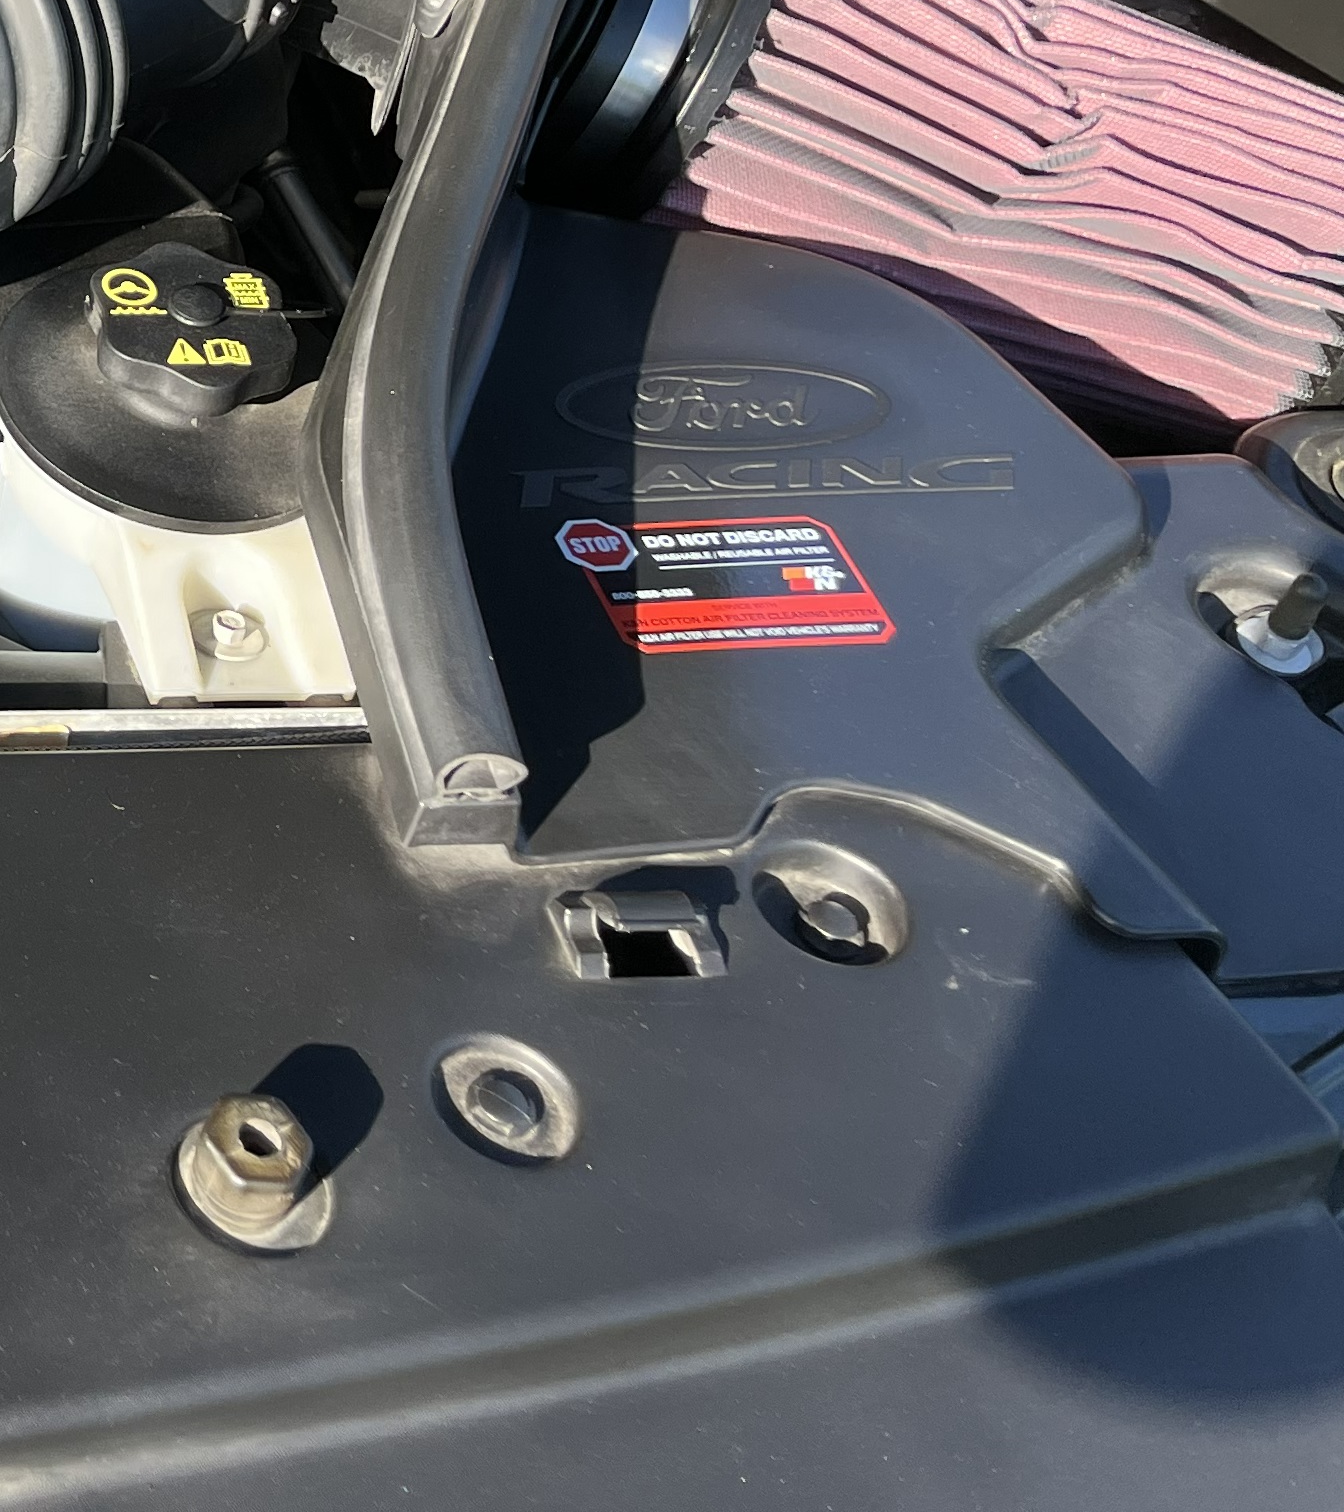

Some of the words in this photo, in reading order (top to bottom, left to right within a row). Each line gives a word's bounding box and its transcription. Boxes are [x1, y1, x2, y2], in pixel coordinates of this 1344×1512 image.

[633, 374, 812, 432] Ford
[512, 453, 1014, 507] RACING
[570, 535, 621, 554] STOP
[641, 535, 675, 549] DO
[675, 532, 721, 548] NOT
[722, 527, 820, 545] DISCARD
[651, 550, 712, 562] WASHABLE
[775, 547, 794, 556] AIR
[794, 546, 830, 555] FILTER
[651, 617, 701, 626] COTTON
[703, 615, 724, 623] AIR
[724, 613, 767, 622] FILTER
[768, 610, 829, 620] CLEANING
[831, 608, 879, 617] SYSTEM
